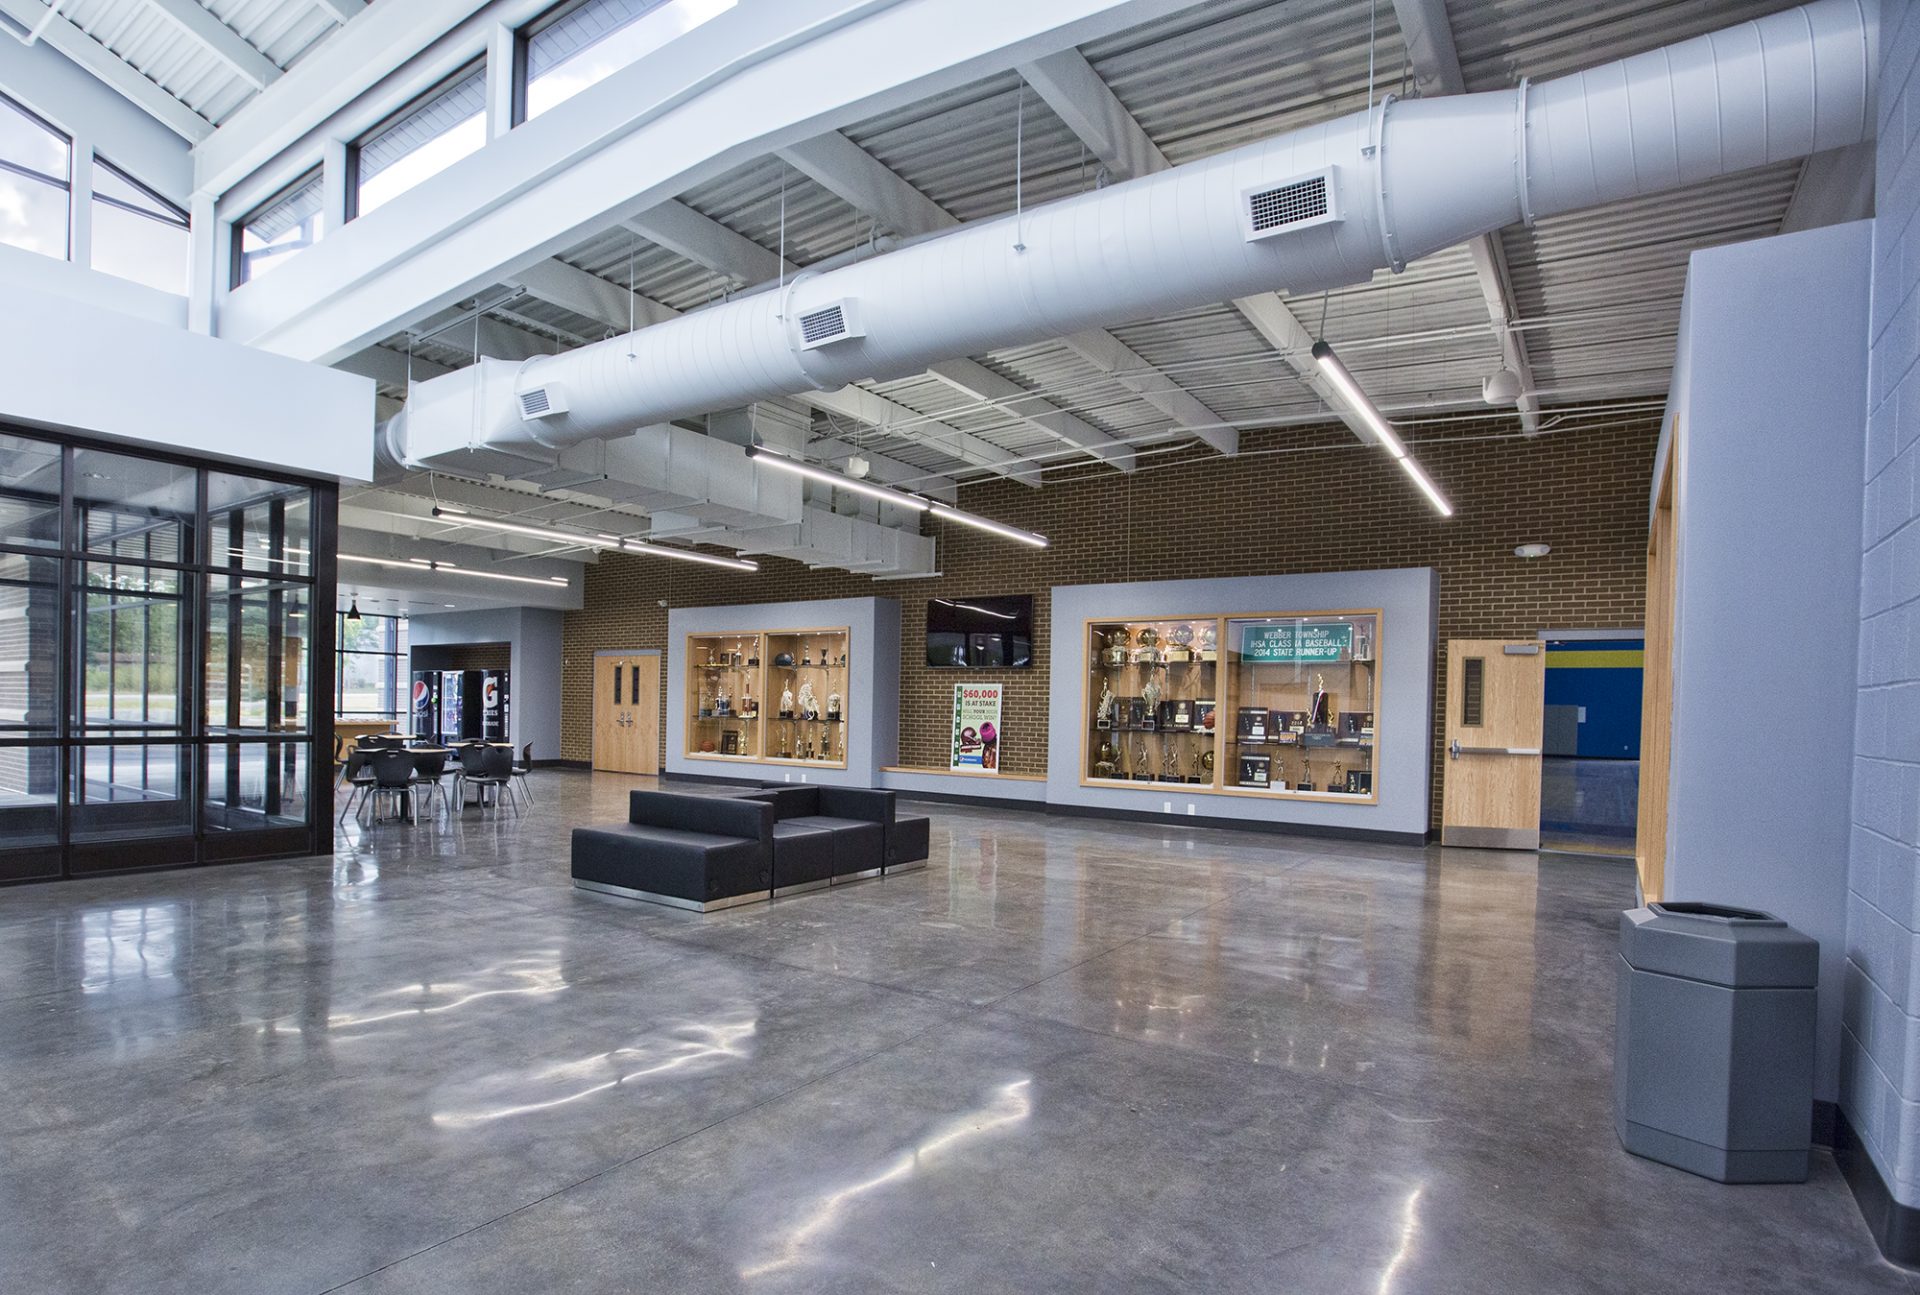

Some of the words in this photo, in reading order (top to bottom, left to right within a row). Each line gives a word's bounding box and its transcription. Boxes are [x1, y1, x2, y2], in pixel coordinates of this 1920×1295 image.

[1264, 631, 1291, 639] WEBBER
[1295, 630, 1330, 639] TOWNSHIP
[1250, 640, 1266, 648] IHSA
[1269, 639, 1292, 648] CLASS
[1305, 639, 1342, 647] BASEBALL
[1254, 648, 1270, 657] 2014
[1273, 648, 1293, 657] STATE
[1295, 647, 1337, 656] RUNNER-UP
[963, 689, 998, 699] $60,000
